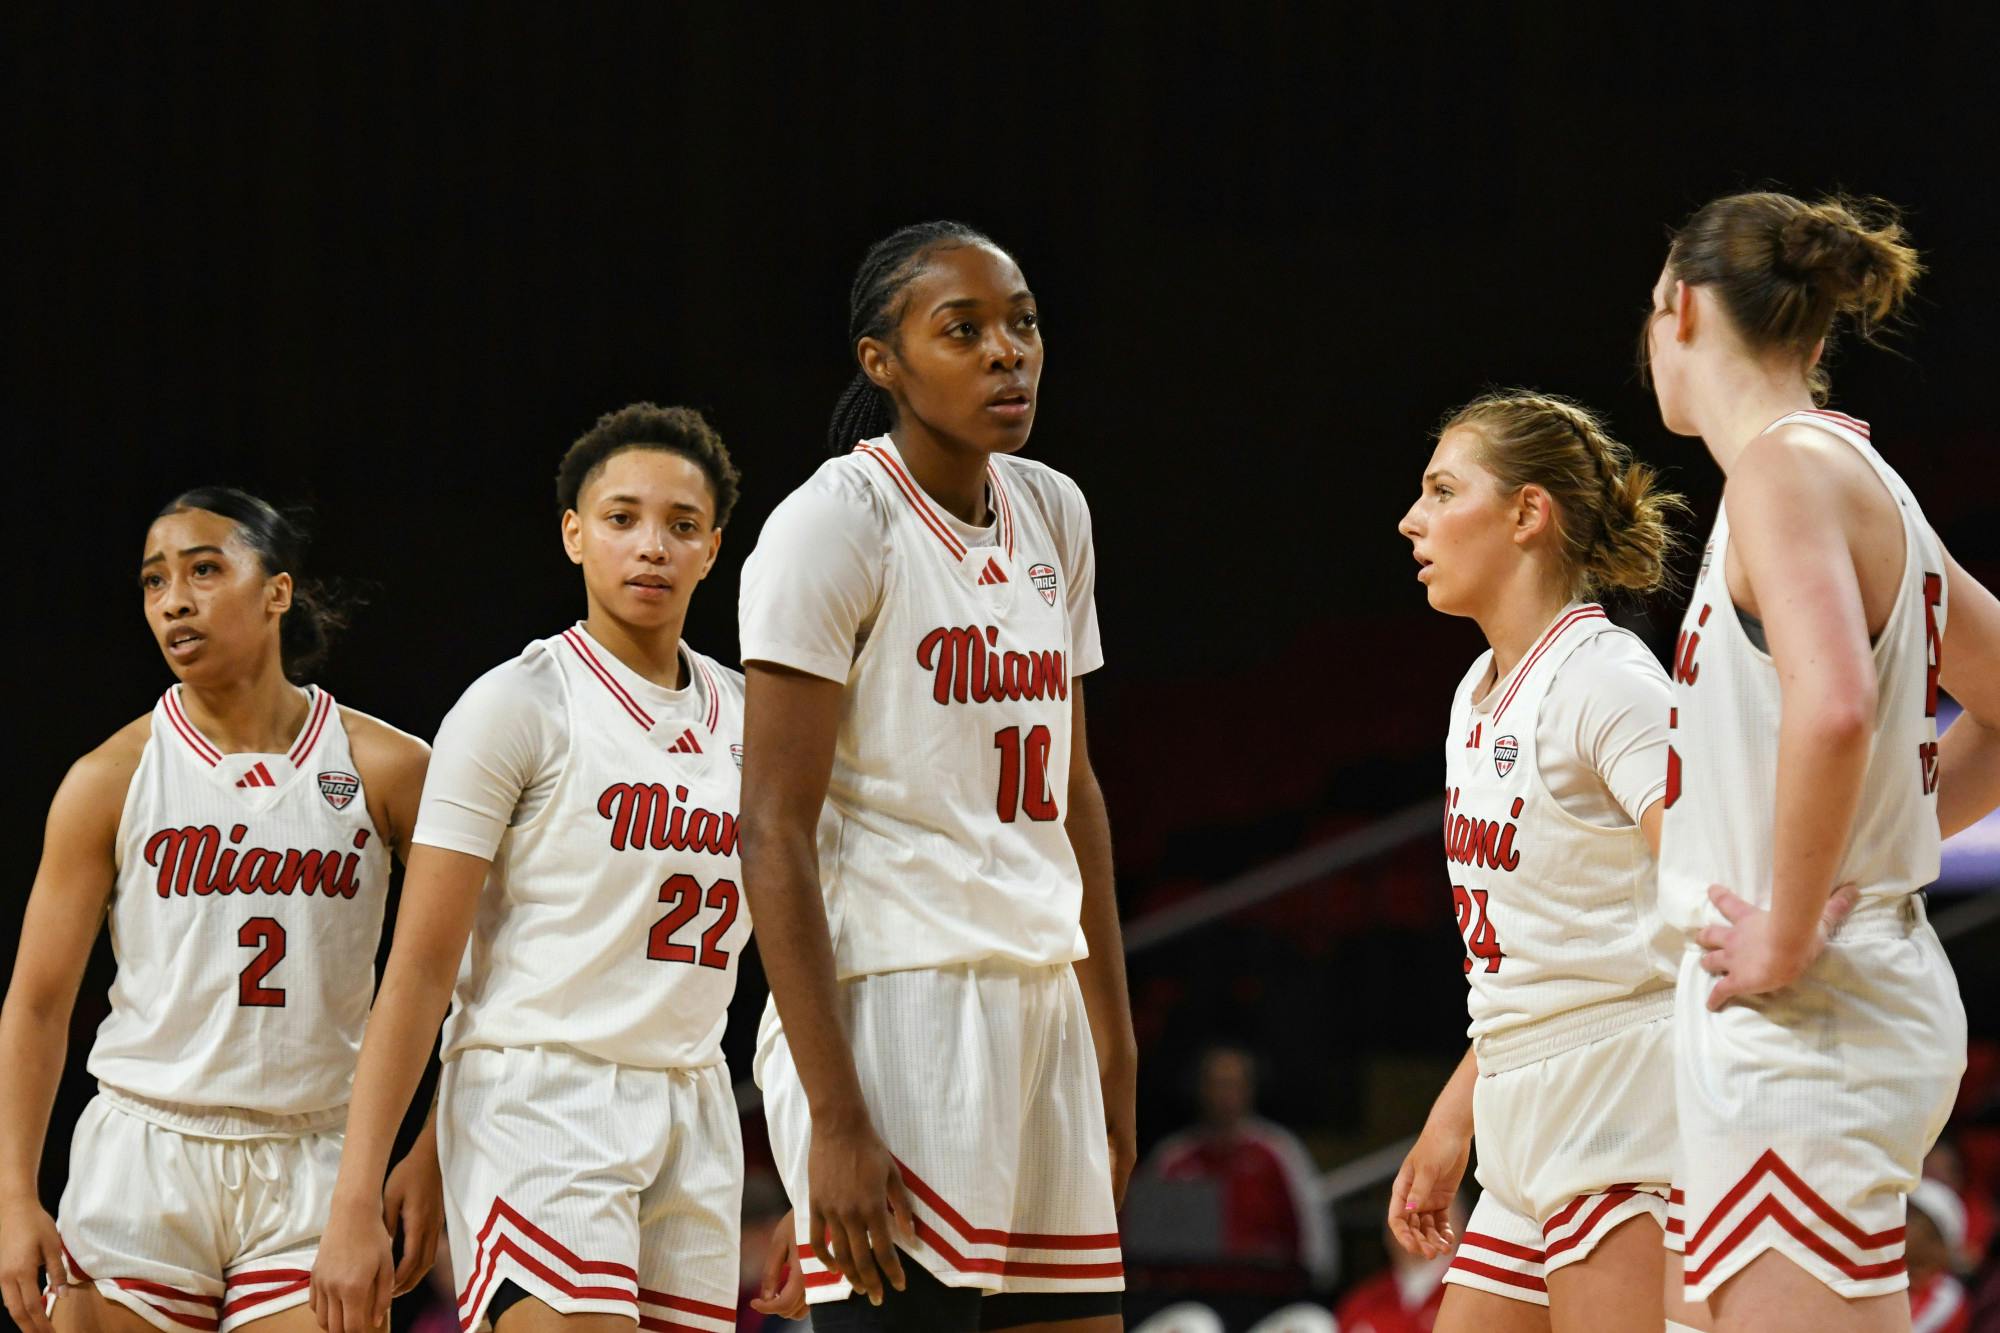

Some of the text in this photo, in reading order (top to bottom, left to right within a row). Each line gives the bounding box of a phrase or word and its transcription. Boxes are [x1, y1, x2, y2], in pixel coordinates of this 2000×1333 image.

[1033, 577, 1057, 590] MAC
[917, 624, 1067, 705] Miam
[321, 781, 357, 797] MAC
[994, 725, 1059, 823] 10
[144, 823, 371, 900] Miami
[238, 916, 287, 1008] 2
[647, 873, 739, 970] 22
